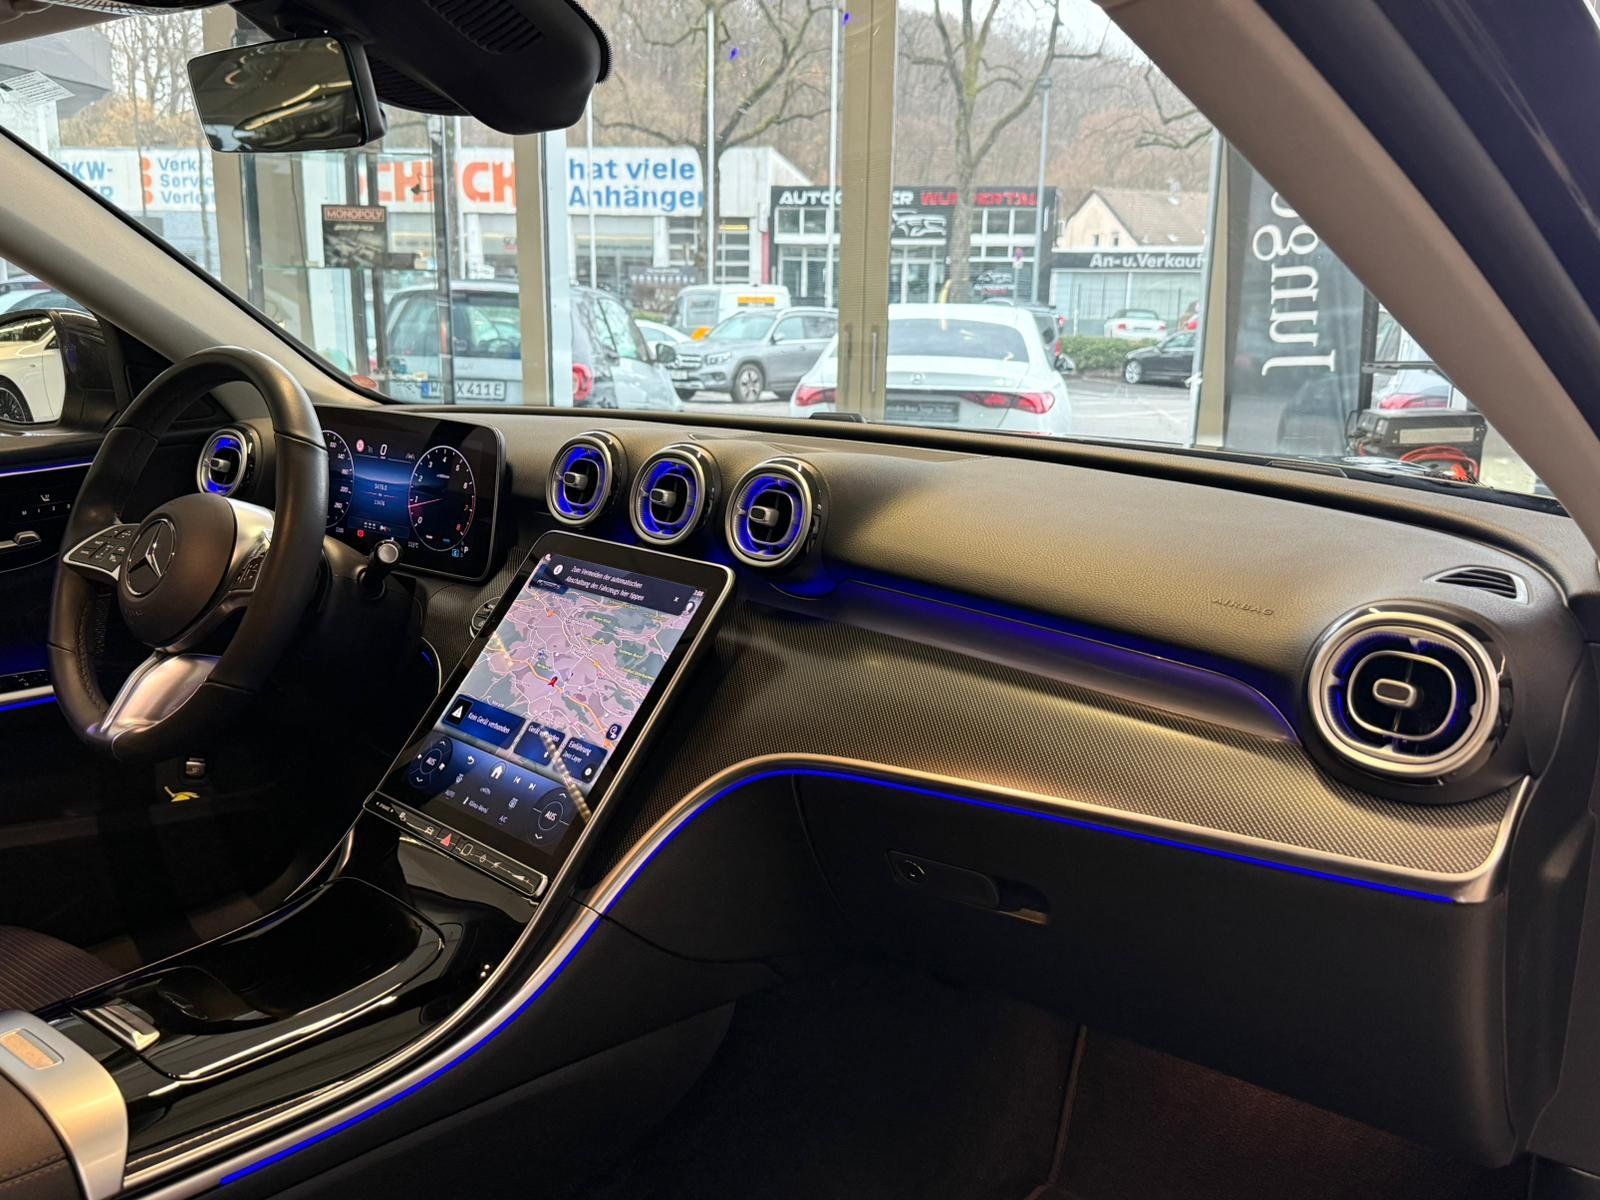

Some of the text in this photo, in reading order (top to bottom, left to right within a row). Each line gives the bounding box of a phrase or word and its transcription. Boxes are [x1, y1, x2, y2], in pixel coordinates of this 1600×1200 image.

[569, 157, 695, 179] hat viele
[160, 174, 214, 188] Servc
[327, 208, 384, 220] MONOPOLY
[477, 715, 489, 726] Gerät
[528, 725, 540, 735] Gerät
[545, 811, 557, 822] AUS
